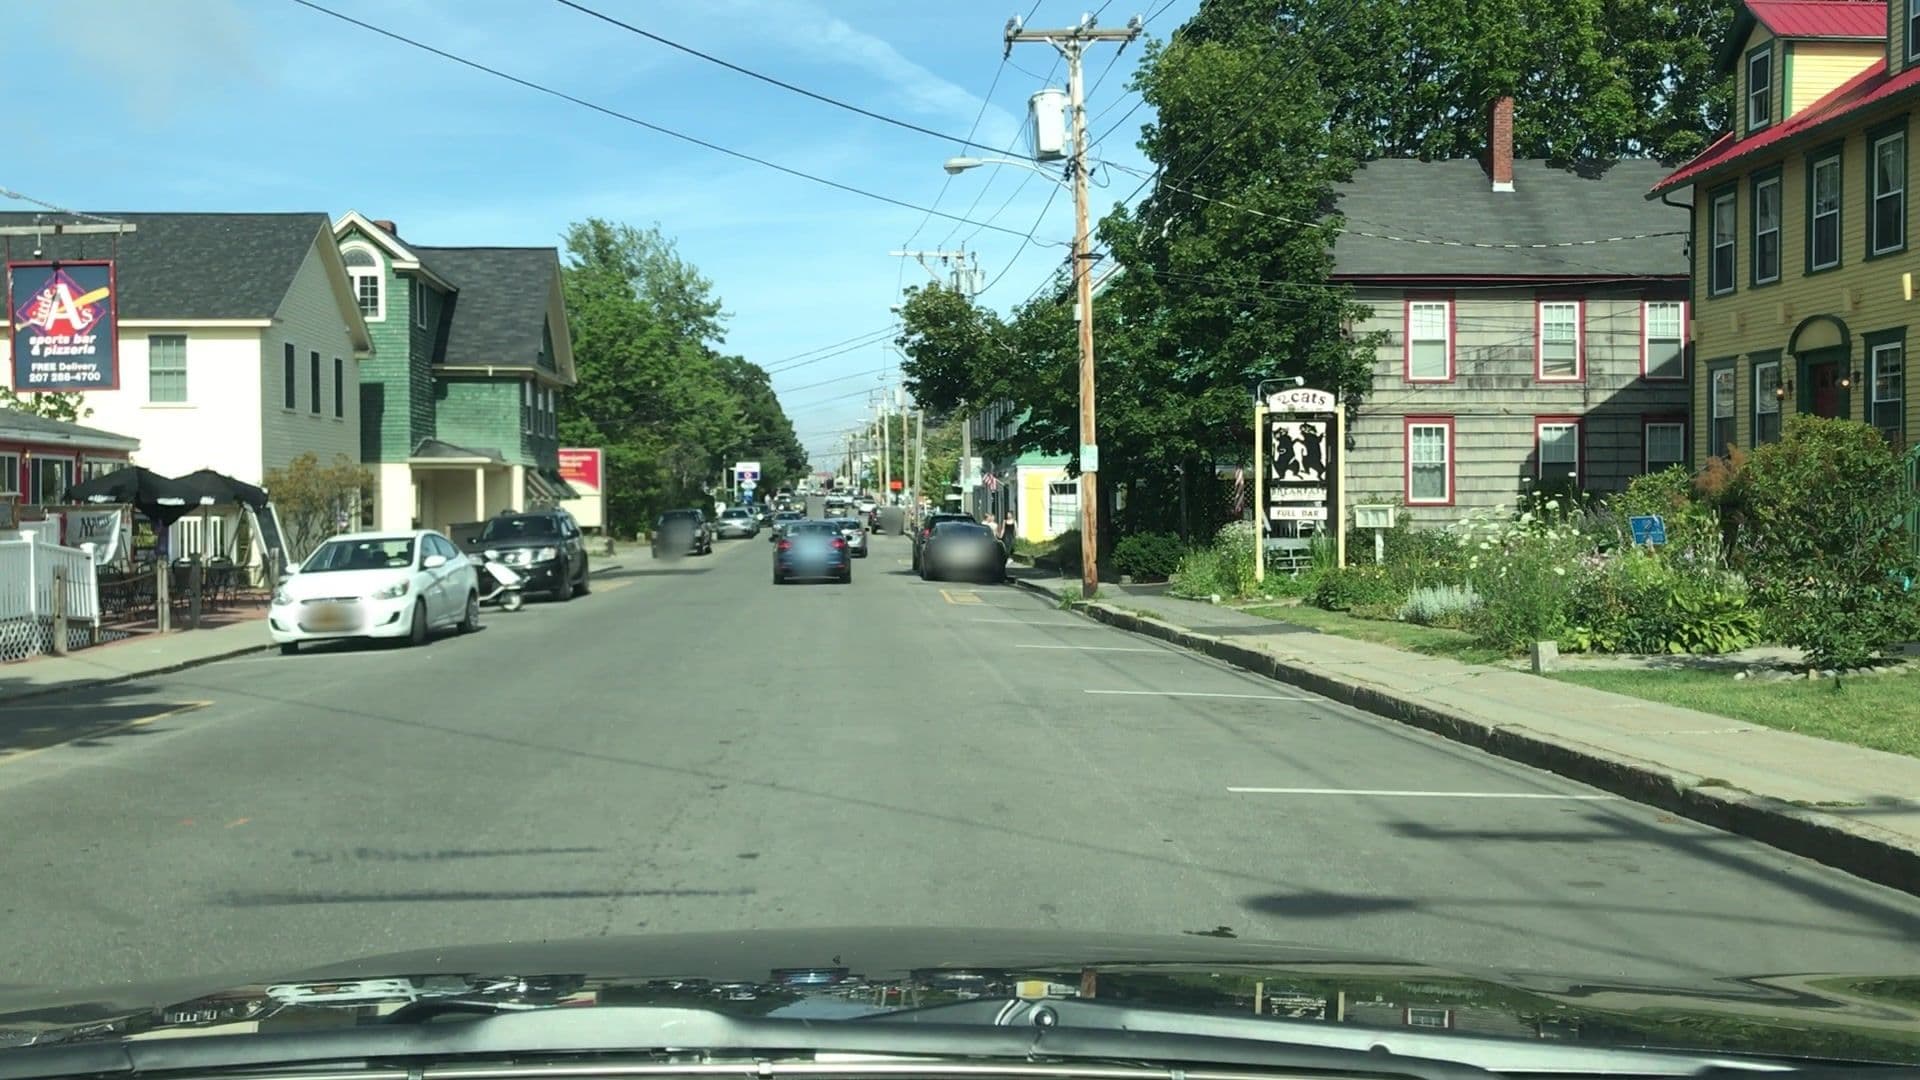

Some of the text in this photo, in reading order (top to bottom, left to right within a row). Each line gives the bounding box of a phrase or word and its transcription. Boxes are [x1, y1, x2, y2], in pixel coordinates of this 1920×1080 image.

[29, 333, 97, 346] sports bar
[43, 344, 96, 358] pizzeria
[31, 362, 97, 372] FREE Delivery
[29, 371, 101, 383] 207 288-4700
[1291, 392, 1326, 405] cats
